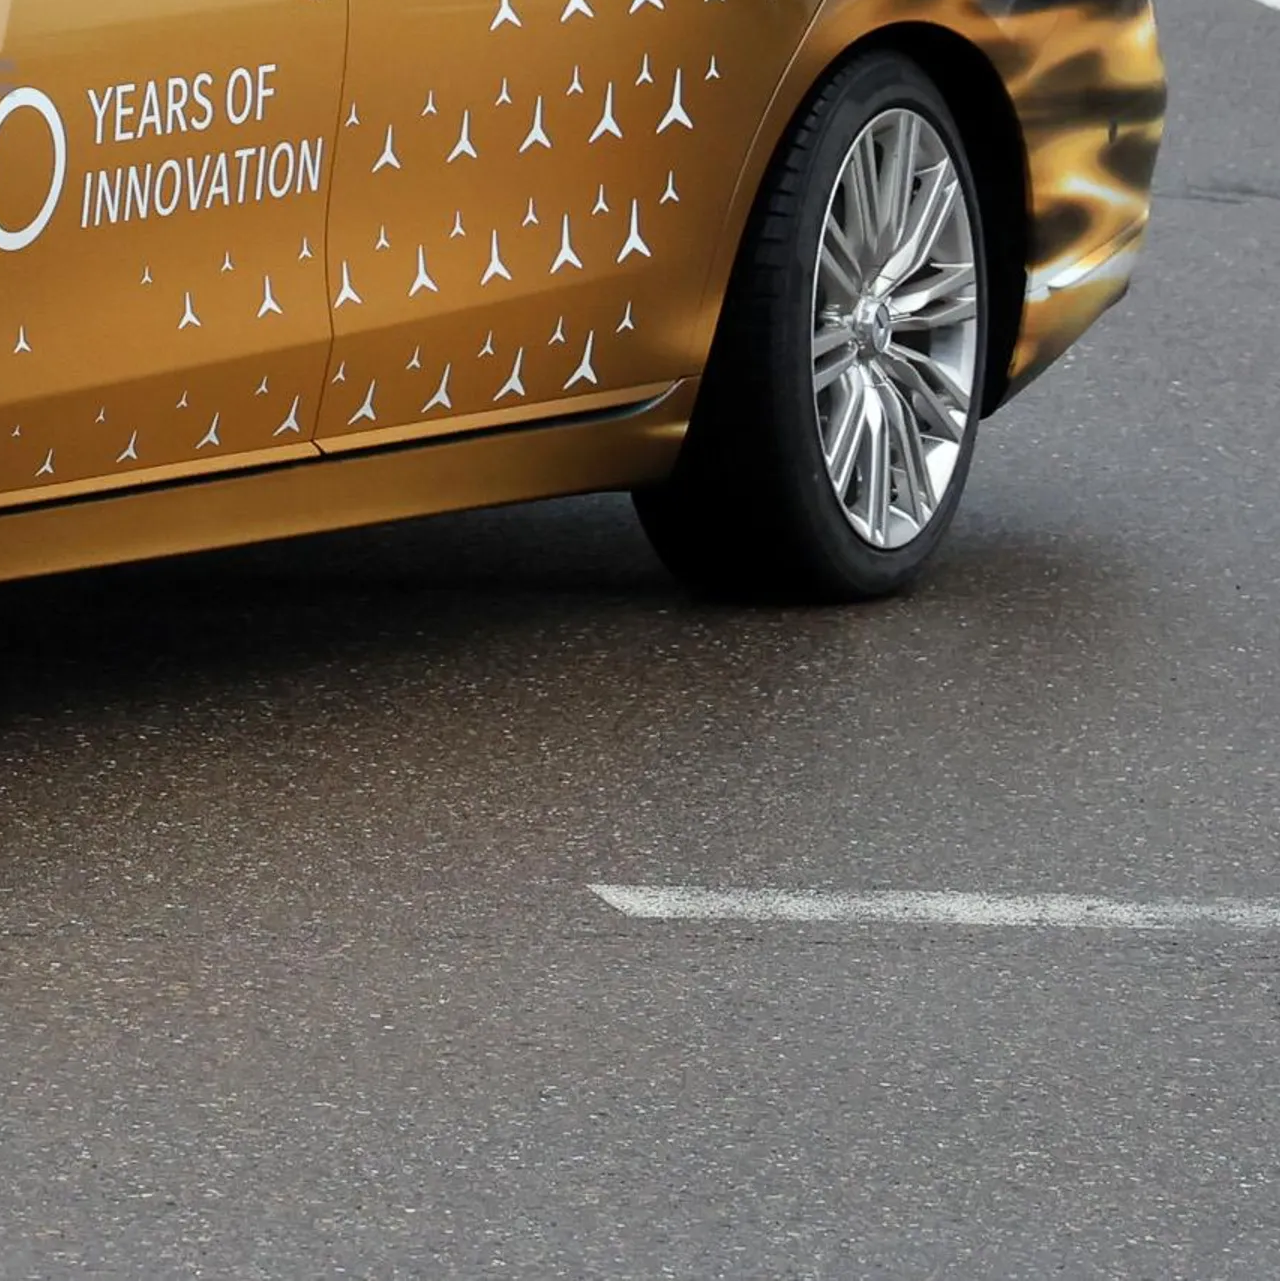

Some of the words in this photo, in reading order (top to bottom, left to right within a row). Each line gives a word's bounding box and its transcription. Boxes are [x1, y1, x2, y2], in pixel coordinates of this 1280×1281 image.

[87, 72, 213, 145] YEARS
[225, 63, 277, 125] OF
[80, 136, 323, 229] INNOVATION
